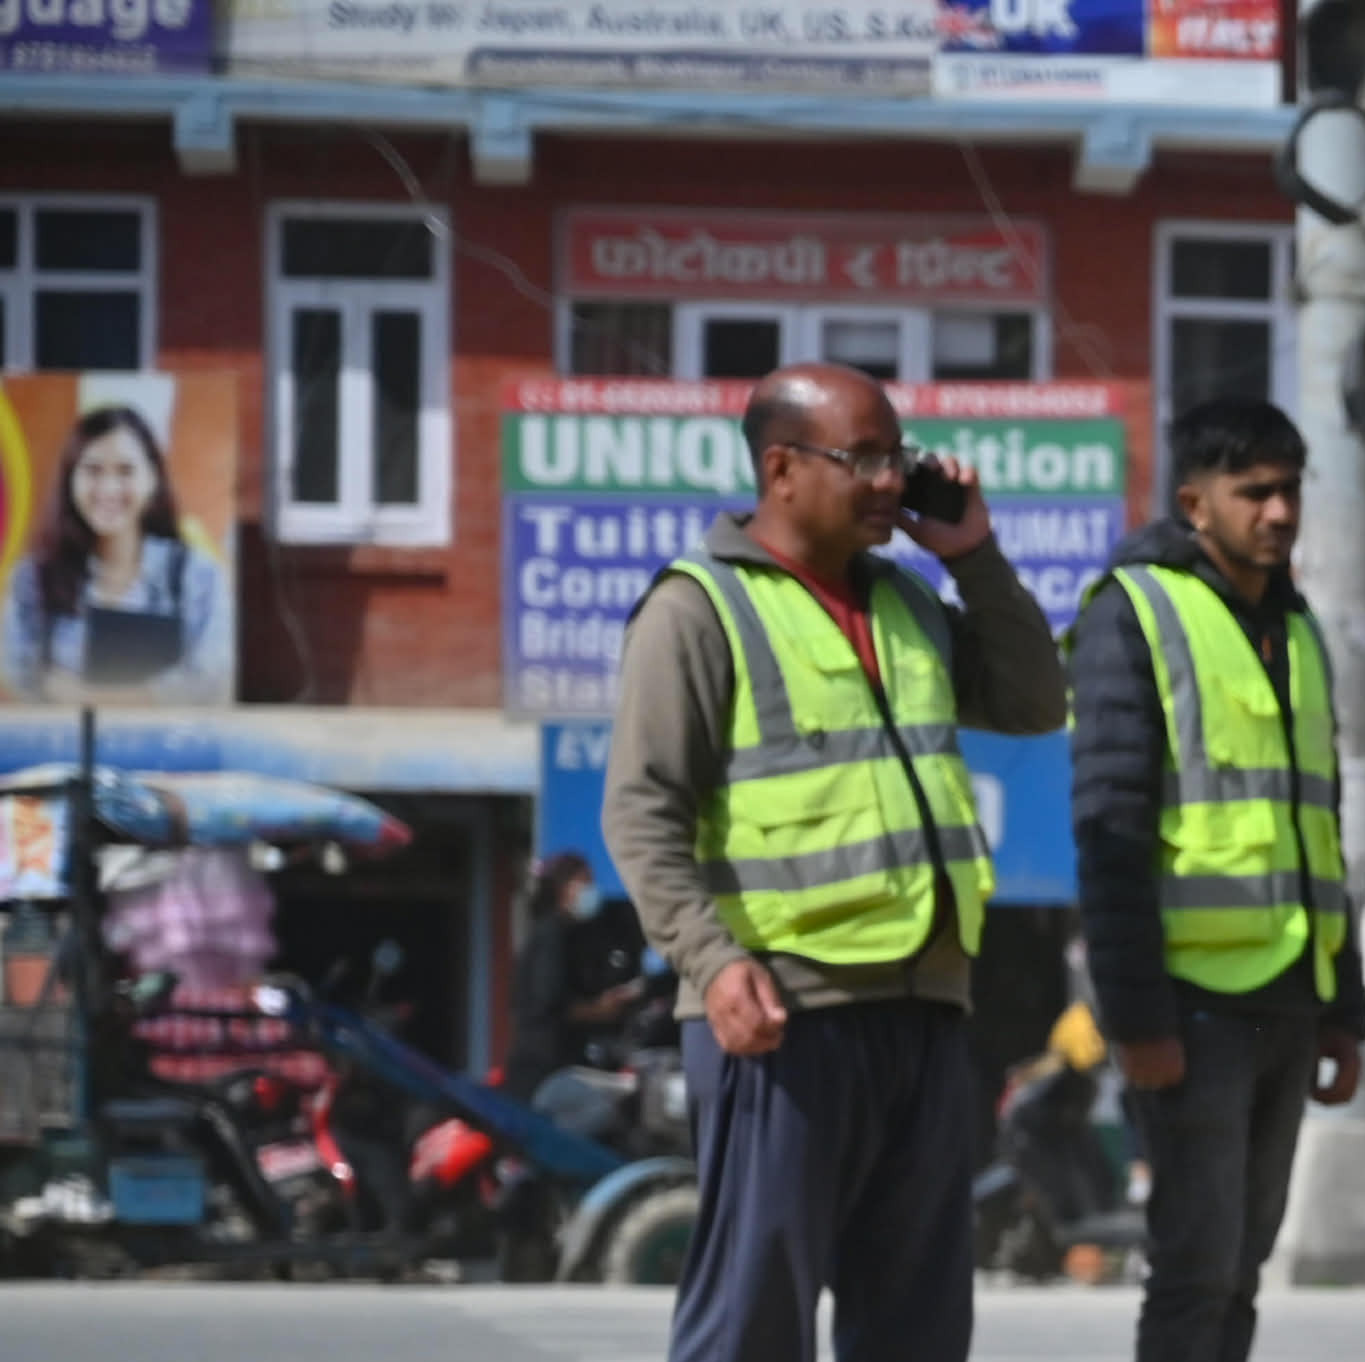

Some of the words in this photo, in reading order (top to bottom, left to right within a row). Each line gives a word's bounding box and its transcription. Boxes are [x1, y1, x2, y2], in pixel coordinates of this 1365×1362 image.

[328, 0, 415, 35] Study
[991, 0, 1078, 38] UK
[902, 428, 1115, 489] ition
